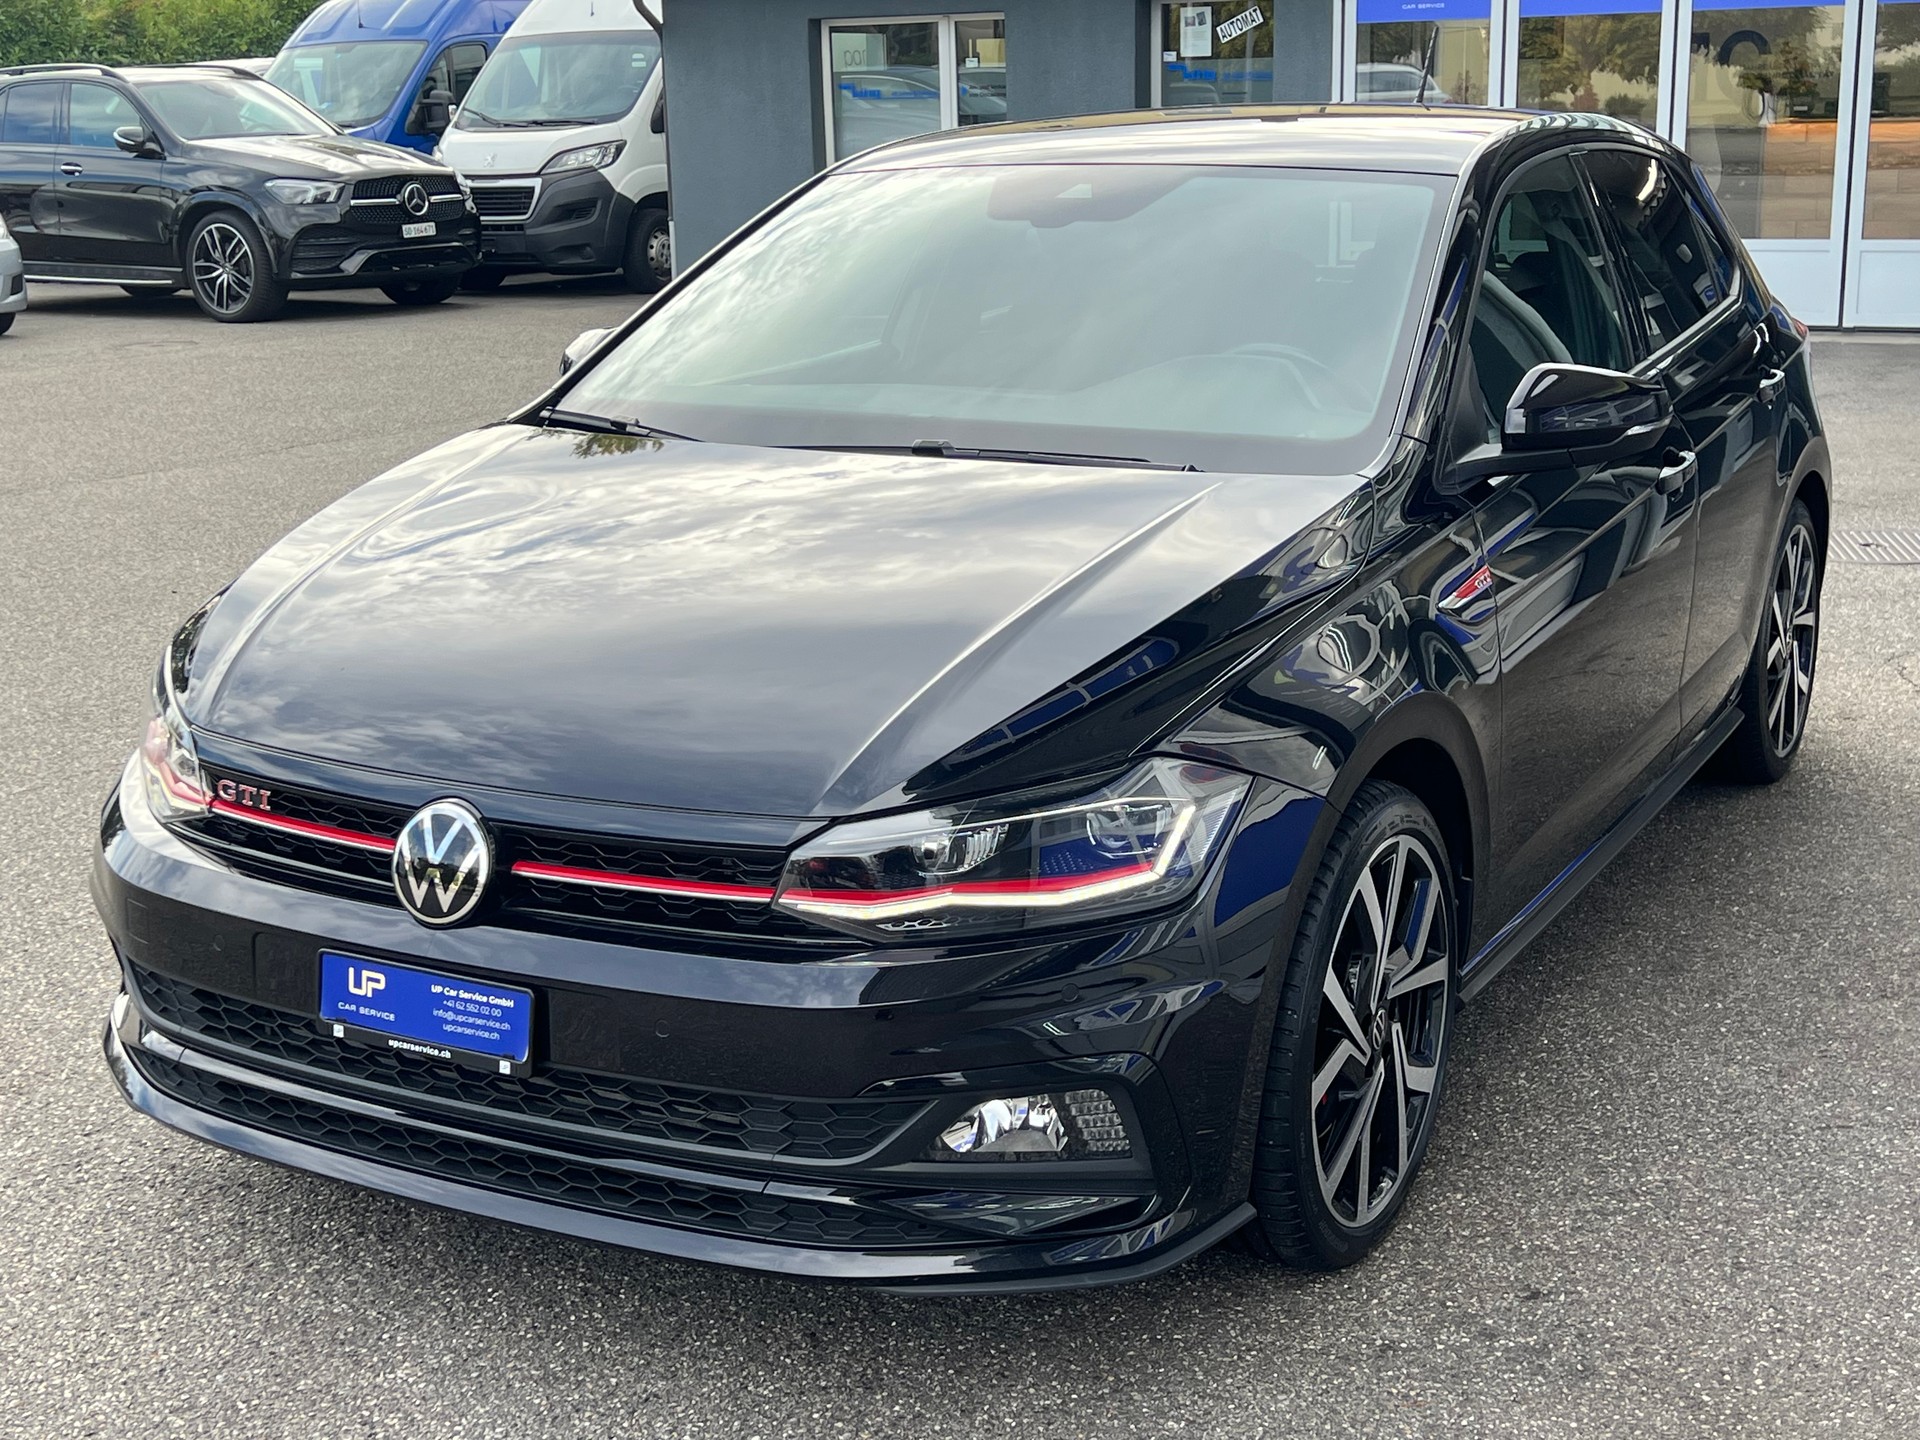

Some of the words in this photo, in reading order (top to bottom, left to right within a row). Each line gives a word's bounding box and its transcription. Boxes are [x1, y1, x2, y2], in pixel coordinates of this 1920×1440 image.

[1220, 8, 1262, 40] AUTOMAT
[217, 779, 271, 811] GTI
[397, 806, 486, 916] VW
[348, 966, 386, 998] UP
[431, 984, 443, 994] UP
[443, 987, 458, 997] Car
[458, 990, 488, 1003] Service
[489, 995, 515, 1008] GmbH
[338, 1001, 357, 1012] CAR
[358, 1006, 396, 1022] SERVICE
[432, 1007, 512, 1031] info@upcarservice.ch
[443, 1000, 455, 1008] +41
[455, 1001, 466, 1011] 62
[466, 1002, 480, 1013] 552
[480, 1006, 490, 1015] 02
[491, 1007, 502, 1018] 00
[442, 1023, 501, 1041] upcarservice.ch
[388, 1039, 452, 1059] upcarservice.ch
